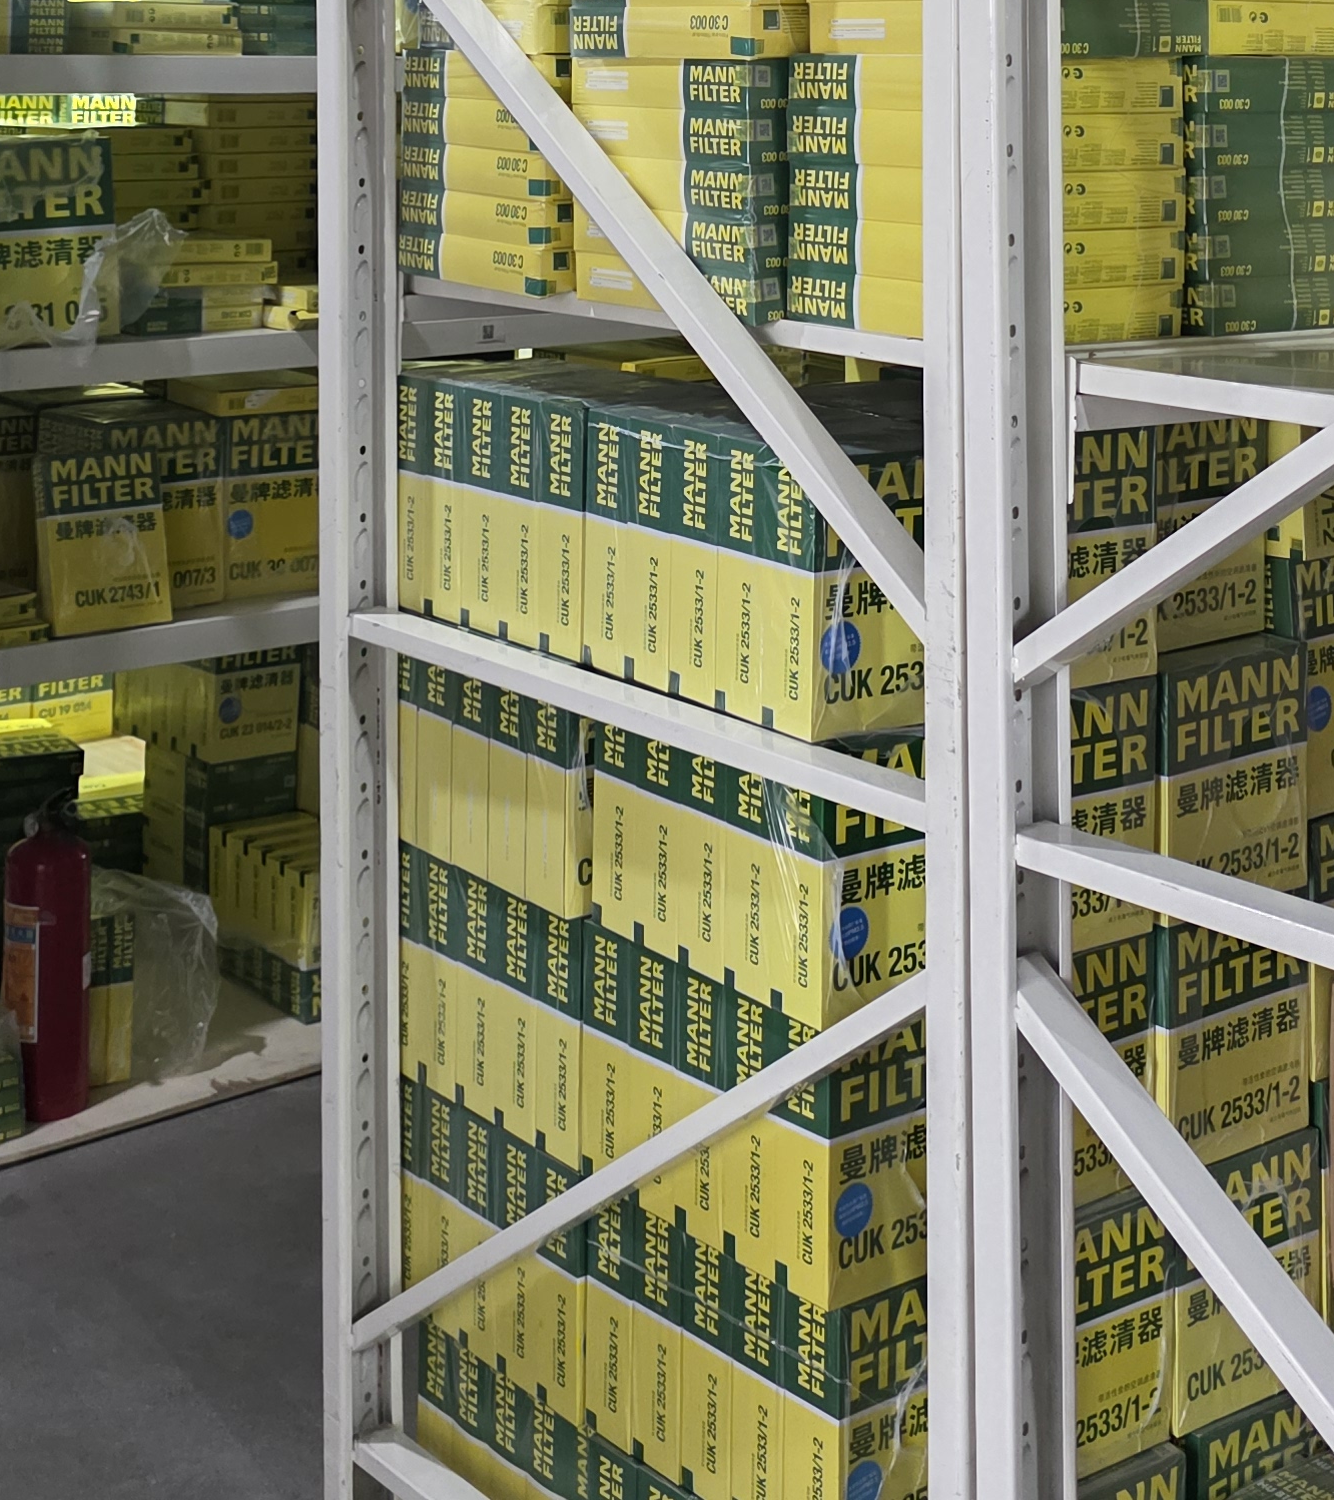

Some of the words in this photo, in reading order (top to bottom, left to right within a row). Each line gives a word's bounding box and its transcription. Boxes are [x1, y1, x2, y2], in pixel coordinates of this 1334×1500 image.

[29, 27, 63, 35] FILTER
[794, 63, 847, 80] FILTER
[72, 96, 136, 110] MANN
[72, 111, 135, 124] FILTER
[497, 156, 511, 170] 003
[512, 158, 521, 172] 30
[522, 159, 528, 172] C
[691, 170, 742, 189] MANN
[691, 190, 742, 209] FILTER
[400, 234, 434, 254] FILTER
[399, 251, 434, 271] MANN
[435, 392, 444, 467] MANN
[443, 393, 454, 470] FILTER
[51, 453, 151, 483] MANN
[683, 440, 695, 526] MANN
[52, 477, 154, 509] FILTER
[695, 443, 707, 530] FILTER
[562, 535, 570, 599] 2533/1-2
[76, 588, 107, 607] CUK
[109, 584, 160, 603] 2743/1
[561, 604, 569, 626] CUK
[741, 582, 751, 649] 2533/1-2
[39, 674, 104, 697] FILTER
[740, 656, 749, 684] CUK
[1177, 655, 1299, 718] MANN
[1177, 697, 1299, 762] FILTER
[1177, 756, 1299, 818] 曼牌滤清器
[703, 843, 713, 909] 2533/1-2
[841, 854, 925, 907] 曼牌滤
[702, 914, 711, 942] CUK
[640, 957, 652, 1043] MANN
[652, 962, 664, 1048] FILTER
[1178, 999, 1300, 1070] 曼牌滤清器
[1178, 1105, 1216, 1144] CUK
[1220, 1075, 1300, 1129] 2533/1-2
[803, 1160, 814, 1230] 2533/1-2
[802, 1234, 813, 1265] CUK
[798, 1297, 811, 1389] MANN
[812, 1308, 825, 1398] FILTER
